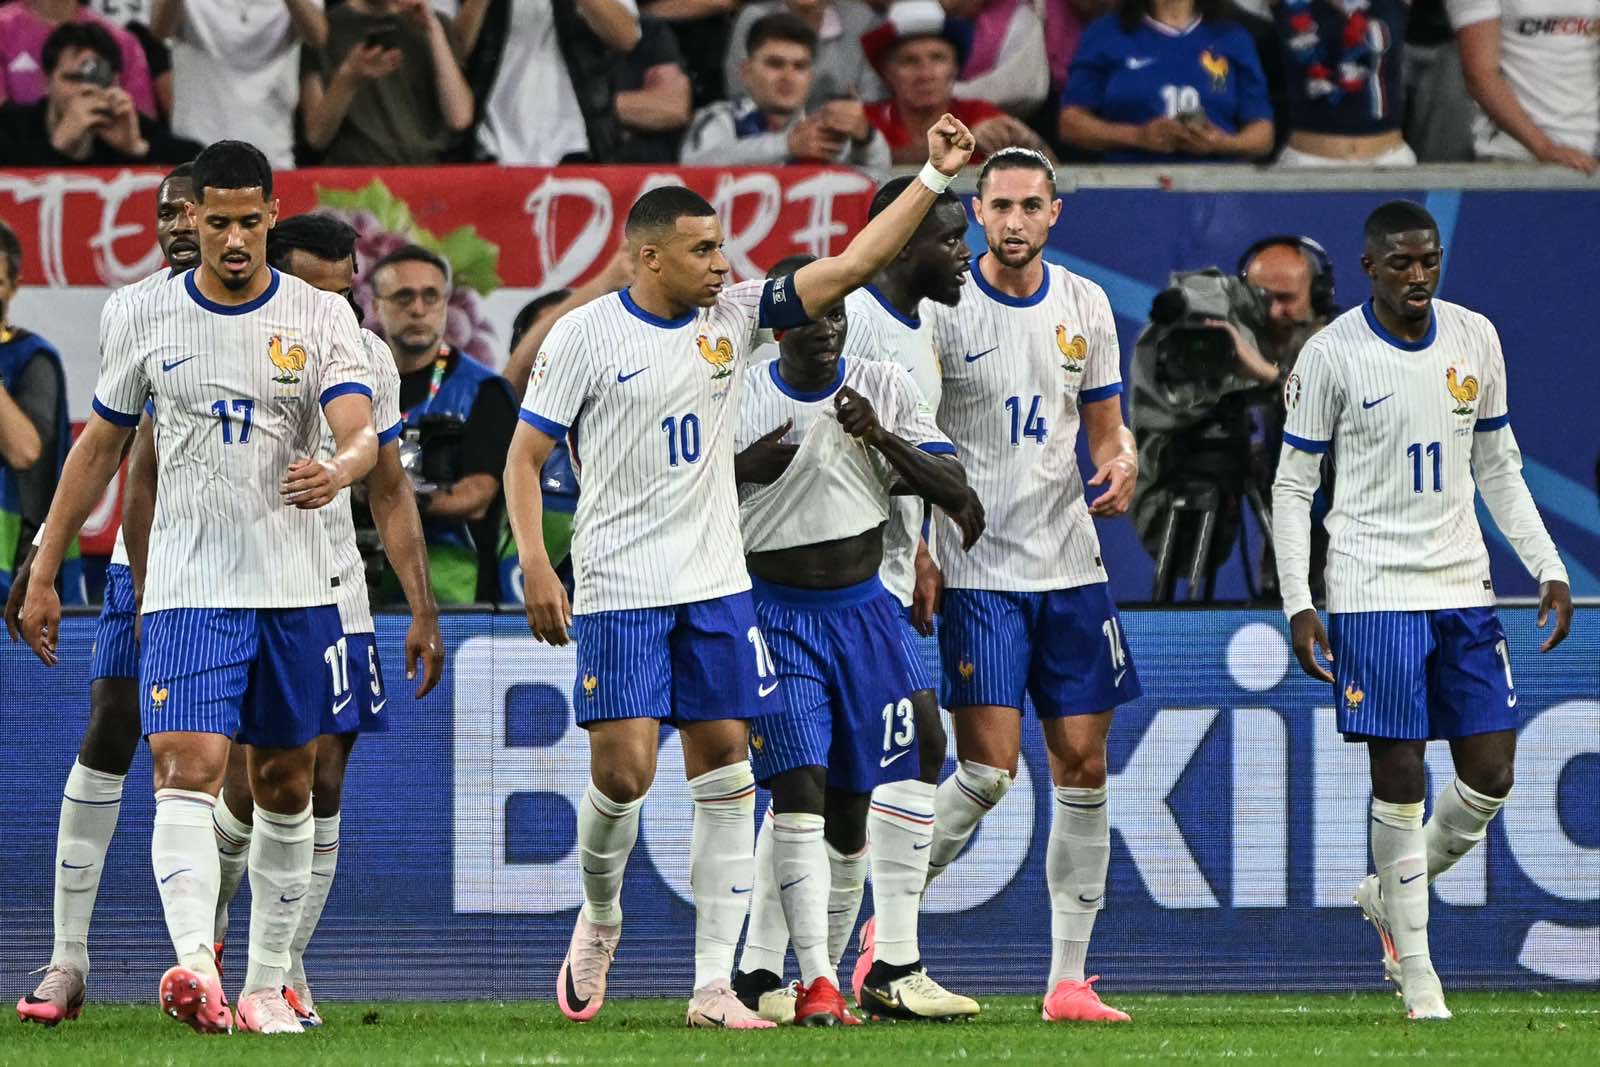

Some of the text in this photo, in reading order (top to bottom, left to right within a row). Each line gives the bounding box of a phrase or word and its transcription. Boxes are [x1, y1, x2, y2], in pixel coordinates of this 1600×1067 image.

[211, 398, 255, 445] 17
[661, 412, 702, 468] 10
[1004, 394, 1049, 447] 14
[1406, 441, 1443, 494] 11
[367, 645, 381, 697] 5
[881, 697, 915, 752] 13
